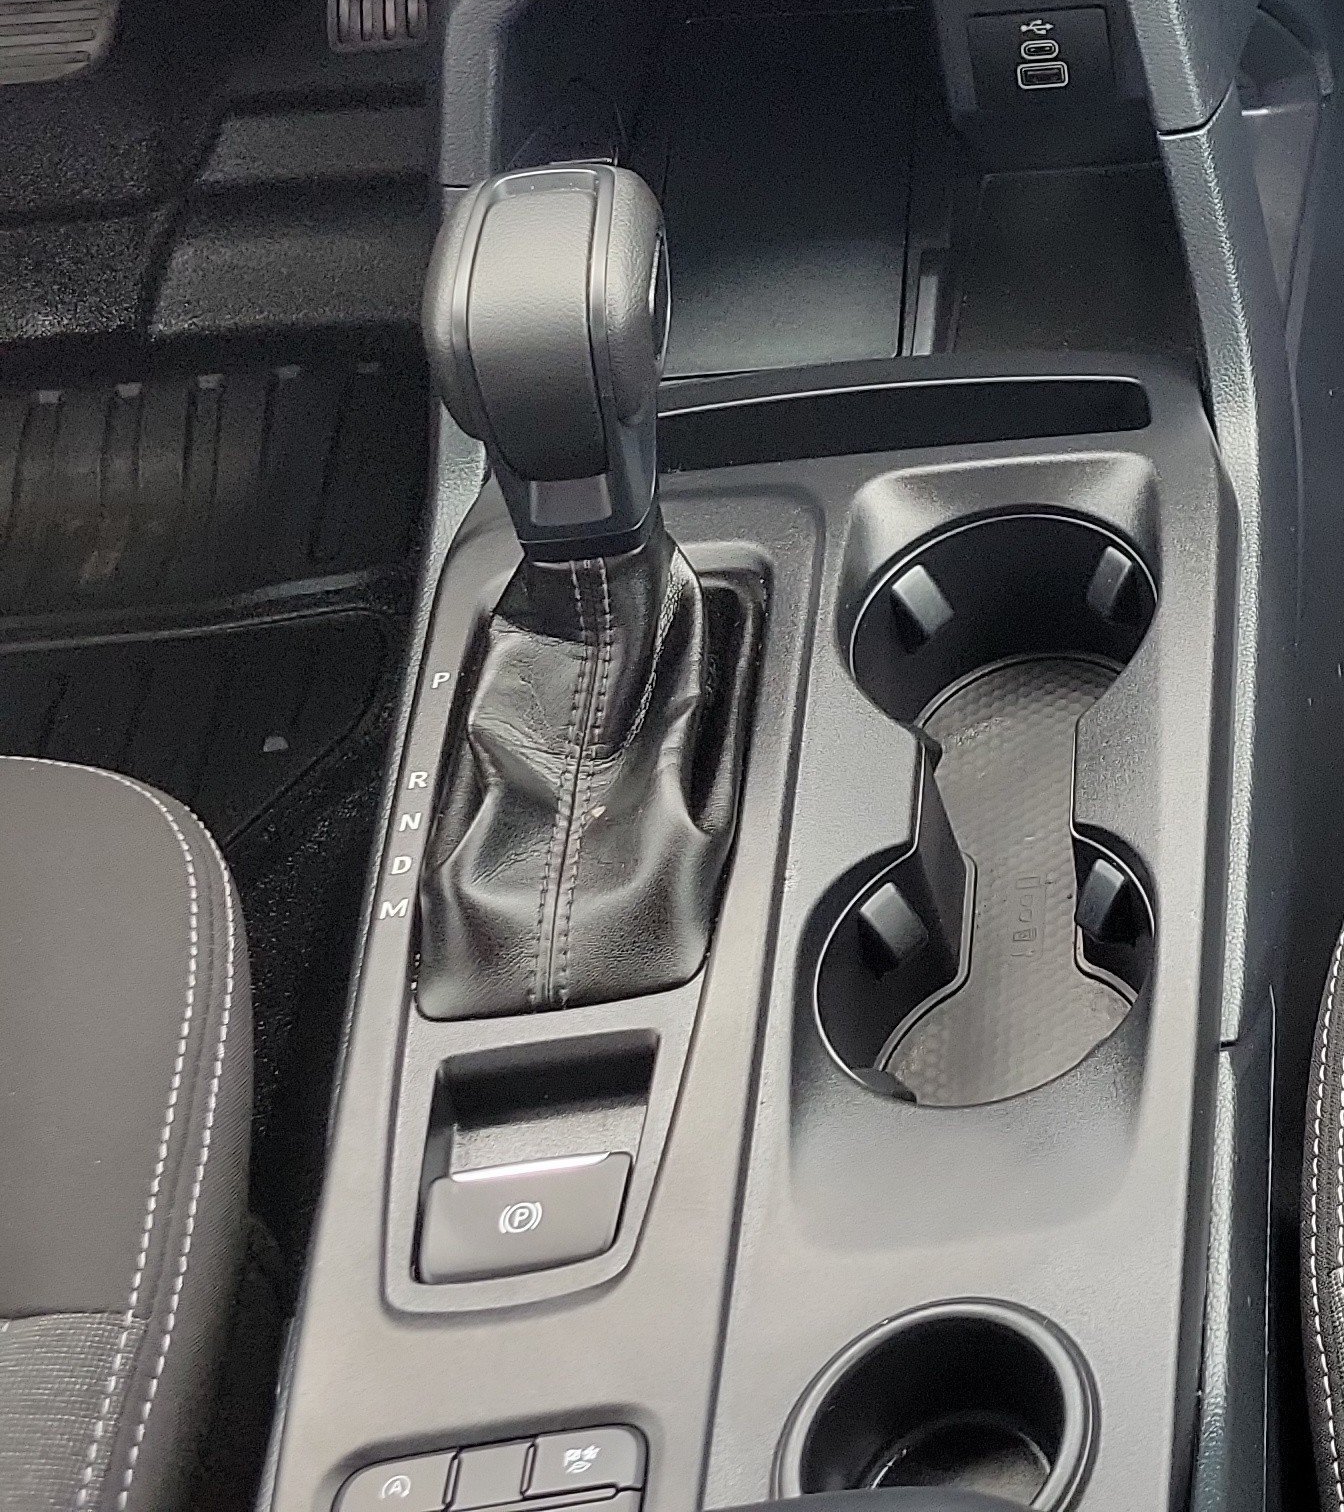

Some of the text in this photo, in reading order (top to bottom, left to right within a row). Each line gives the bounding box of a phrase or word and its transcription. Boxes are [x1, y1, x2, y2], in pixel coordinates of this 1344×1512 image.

[431, 672, 450, 689] P
[408, 772, 428, 789] R
[399, 813, 421, 832] N
[391, 856, 412, 875] D
[379, 898, 409, 919] M
